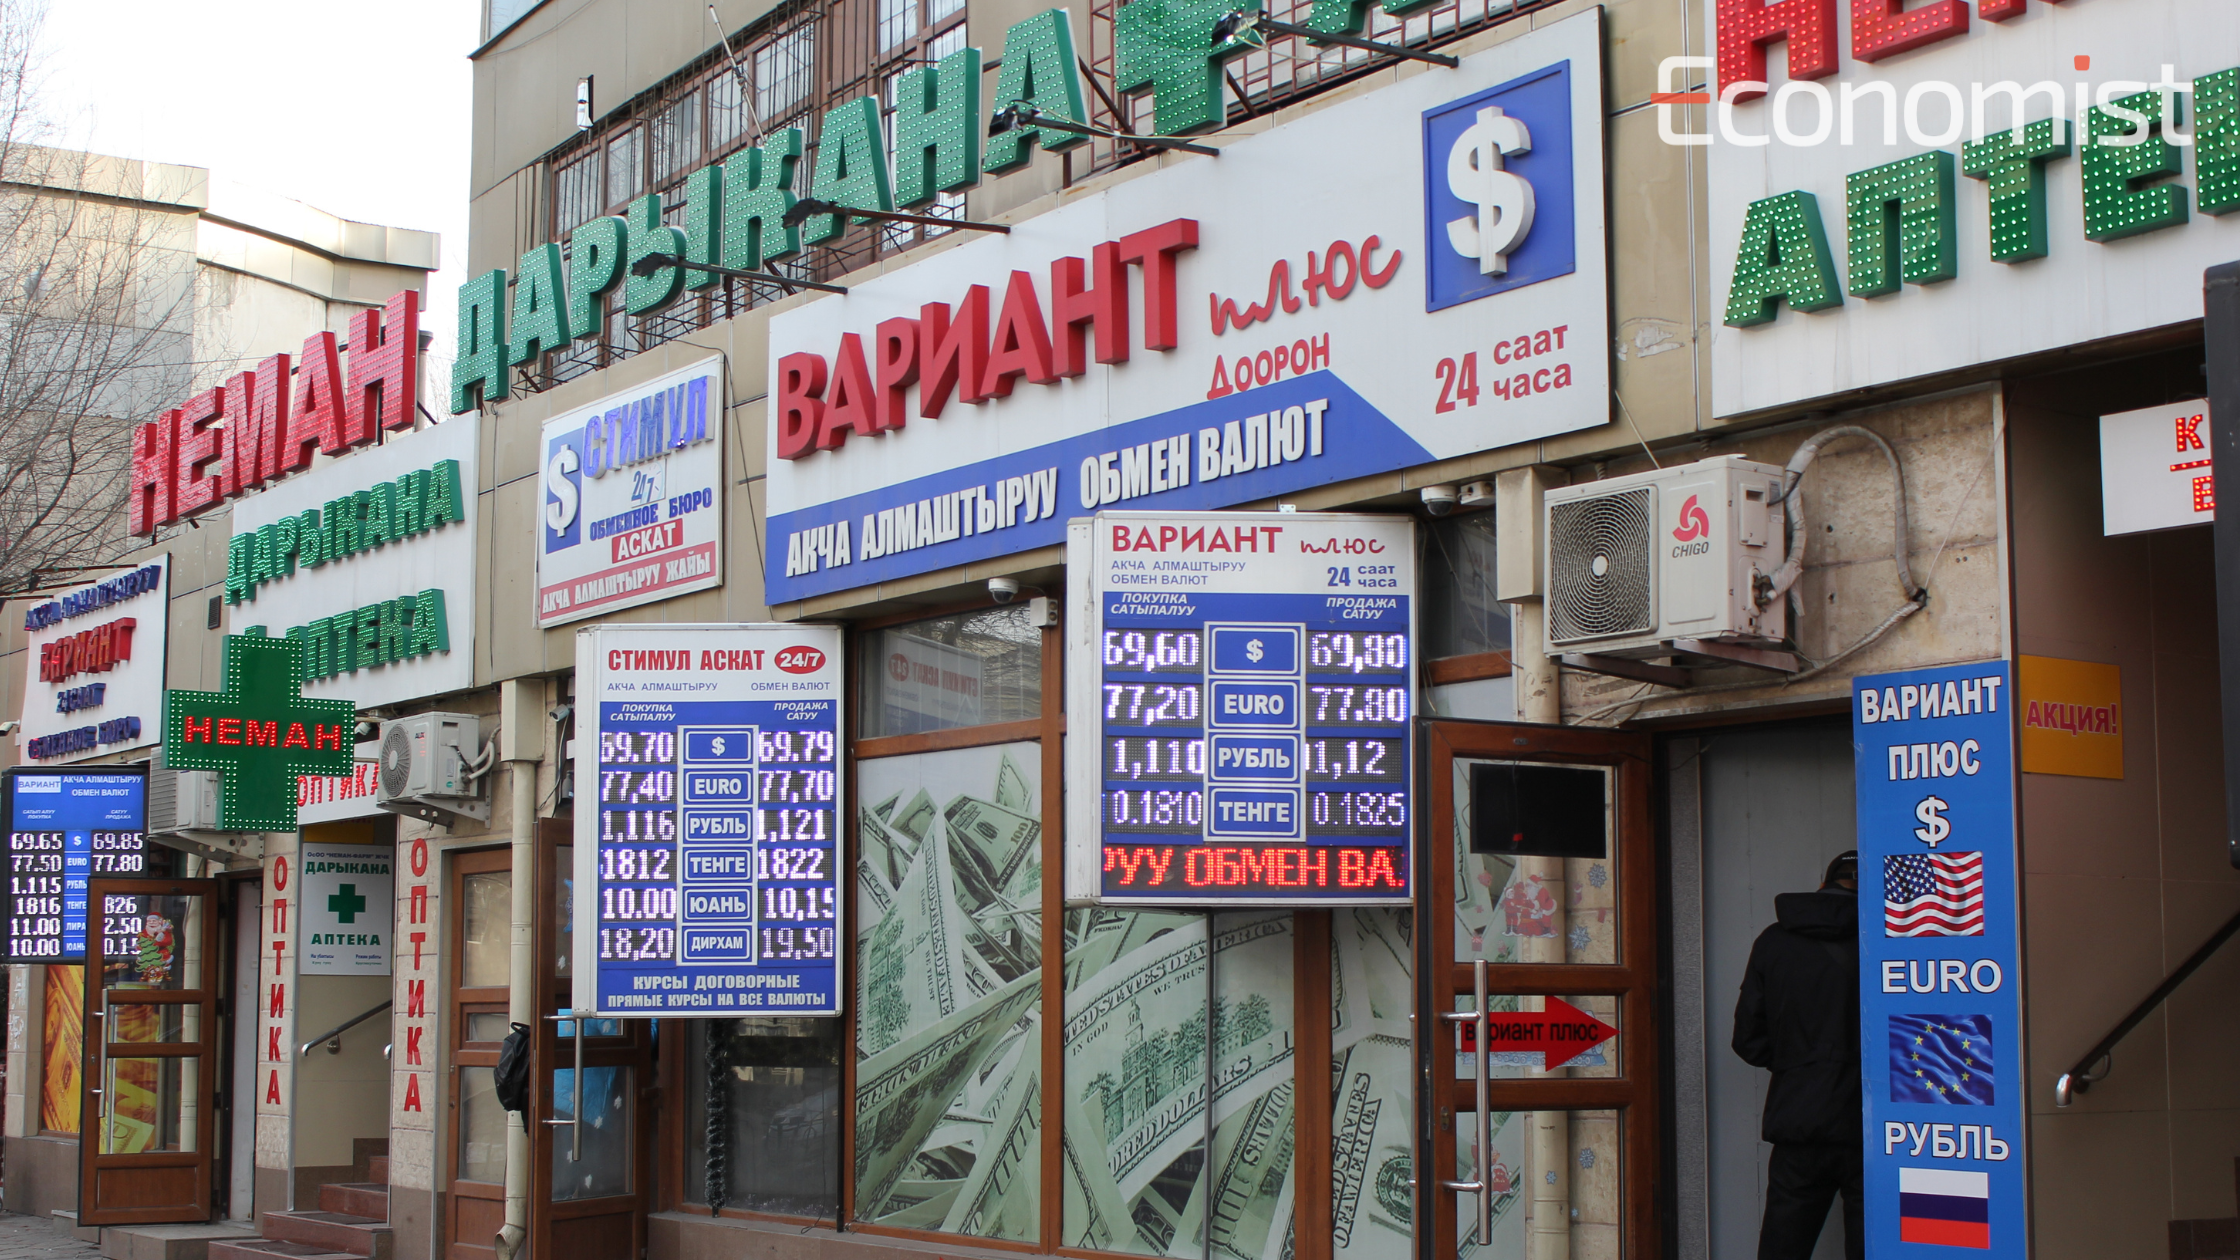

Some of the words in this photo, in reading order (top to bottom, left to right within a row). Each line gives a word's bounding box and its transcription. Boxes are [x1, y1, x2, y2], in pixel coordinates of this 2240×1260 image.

[1447, 106, 1535, 276] $
[451, 8, 1091, 414] ДАРЫКАНА
[777, 217, 1199, 461] ВАРИАНТ
[1435, 352, 1480, 414] 24
[1493, 325, 1568, 366] саат
[1493, 362, 1573, 401] часа
[130, 289, 421, 538] НЕМАН
[583, 375, 717, 479] СТИМУЛ
[546, 444, 579, 538] $
[786, 521, 850, 578] АКЧА
[860, 467, 1058, 562] АЛМАШТЫРУУ
[1080, 431, 1190, 509] ОБМЕН
[1199, 397, 1328, 483] ВАЛЮТ
[589, 503, 659, 541] ОБМЕННОЕ
[669, 487, 712, 517] БЮРО
[225, 459, 465, 606] ДАРЫКАНА
[617, 522, 676, 561] АСКАТ
[1112, 525, 1283, 554] ВАРИАНТ
[1672, 542, 1709, 558] CHIGO
[1111, 560, 1146, 571] АКЧА
[1153, 561, 1246, 572] АЛМАШТЫРУУ
[1327, 566, 1351, 587] 24
[1358, 565, 1395, 575] саат
[542, 587, 571, 614] АКЧА
[574, 563, 661, 605] АЛМАШТЫРУУ
[666, 551, 711, 582] ЖАЙЫ
[1111, 574, 1158, 585] ОБМЕН
[1161, 574, 1208, 585] ВАЛЮТ
[1358, 577, 1397, 588] часа
[1122, 592, 1188, 604] ПОКУПКА
[1326, 597, 1397, 609] ПРОДАЖА
[1342, 608, 1383, 620] САТУУ
[285, 588, 450, 682] ПТЕКА
[39, 617, 136, 683] ВАРИАНТ
[608, 649, 691, 671] СТИМУЛ
[700, 650, 765, 671] АСКАТ
[779, 652, 821, 668] 24/7
[1246, 638, 1264, 663] $
[607, 682, 636, 691] АКЧА
[641, 682, 718, 692] АЛМАШТЫРУУ
[751, 682, 788, 691] ОБМЕН
[792, 681, 830, 691] ВАЛЮТ
[621, 703, 673, 712] ПОКУПКА
[774, 702, 829, 712] ПРОДАЖА
[1224, 693, 1284, 715] EURO
[1860, 675, 2002, 725] ВАРИАНТ
[786, 711, 818, 721] САТУУ
[2025, 700, 2118, 737] АКЦИЯ!
[184, 716, 342, 751] НЕМАН
[711, 736, 726, 756] $
[759, 731, 834, 762] 69.79
[1218, 747, 1291, 769] РУБЛЬ
[1888, 738, 1981, 782] ПЛЮС
[18, 780, 61, 789] ВАРИАНТ
[63, 776, 85, 784] АКЧА
[86, 776, 142, 784] АЛМАШТЫРУУ
[72, 788, 100, 797] ОБМЕН
[101, 788, 129, 797] ВАЛЮТ
[694, 778, 742, 795] EURO
[1113, 790, 1202, 825] 0.1810
[1219, 801, 1291, 822] ТЕНГЕ
[1313, 791, 1405, 826] 0.1825
[690, 817, 746, 834] РУБЛЬ
[1913, 795, 1952, 849] $
[10, 832, 63, 850] 69.65
[73, 835, 82, 846] $
[92, 832, 143, 850] 69.85
[10, 854, 62, 872] 77.50
[67, 858, 88, 866] EURO
[92, 854, 143, 872] 77.80
[305, 861, 390, 875] ДАРЫКАНА
[603, 848, 671, 880] 1812
[690, 856, 746, 874] ТЕНГЕ
[758, 848, 824, 880] 1822
[1184, 848, 1328, 887] ОБМЕН
[1338, 849, 1405, 887] ВА
[11, 876, 62, 894] 1.115
[66, 880, 87, 889] РУБЛЬ
[16, 897, 62, 915] 1816
[67, 901, 87, 910] ТЕНГЕ
[603, 888, 677, 919] 10.00
[690, 896, 746, 914] ЮАНЬ
[10, 917, 61, 936] 11.00
[65, 922, 86, 931] ЛИРА
[10, 938, 61, 957] 10.00
[66, 943, 86, 952] ЮАНЬ
[311, 933, 381, 946] АПТЕКА
[691, 936, 743, 952] ДИРХАМ
[266, 856, 288, 1105] ОПТИКА
[404, 838, 428, 1112] ОПТИКА
[633, 975, 688, 990] КУРСЫ
[694, 974, 800, 991] ДОГОВОРНЫЕ
[1174, 963, 1206, 985] TRUS
[1881, 958, 2003, 994] EURO
[608, 994, 662, 1007] ПРЯМЫЕ
[668, 994, 712, 1007] КУРСЫ
[718, 994, 734, 1006] НА
[739, 993, 763, 1006] ВСЕ
[768, 992, 826, 1006] ВАЛЮТЫ
[1465, 1022, 1544, 1047] вриант
[1550, 1022, 1599, 1042] плюс
[1884, 1120, 2011, 1161] РУБЛЬ
